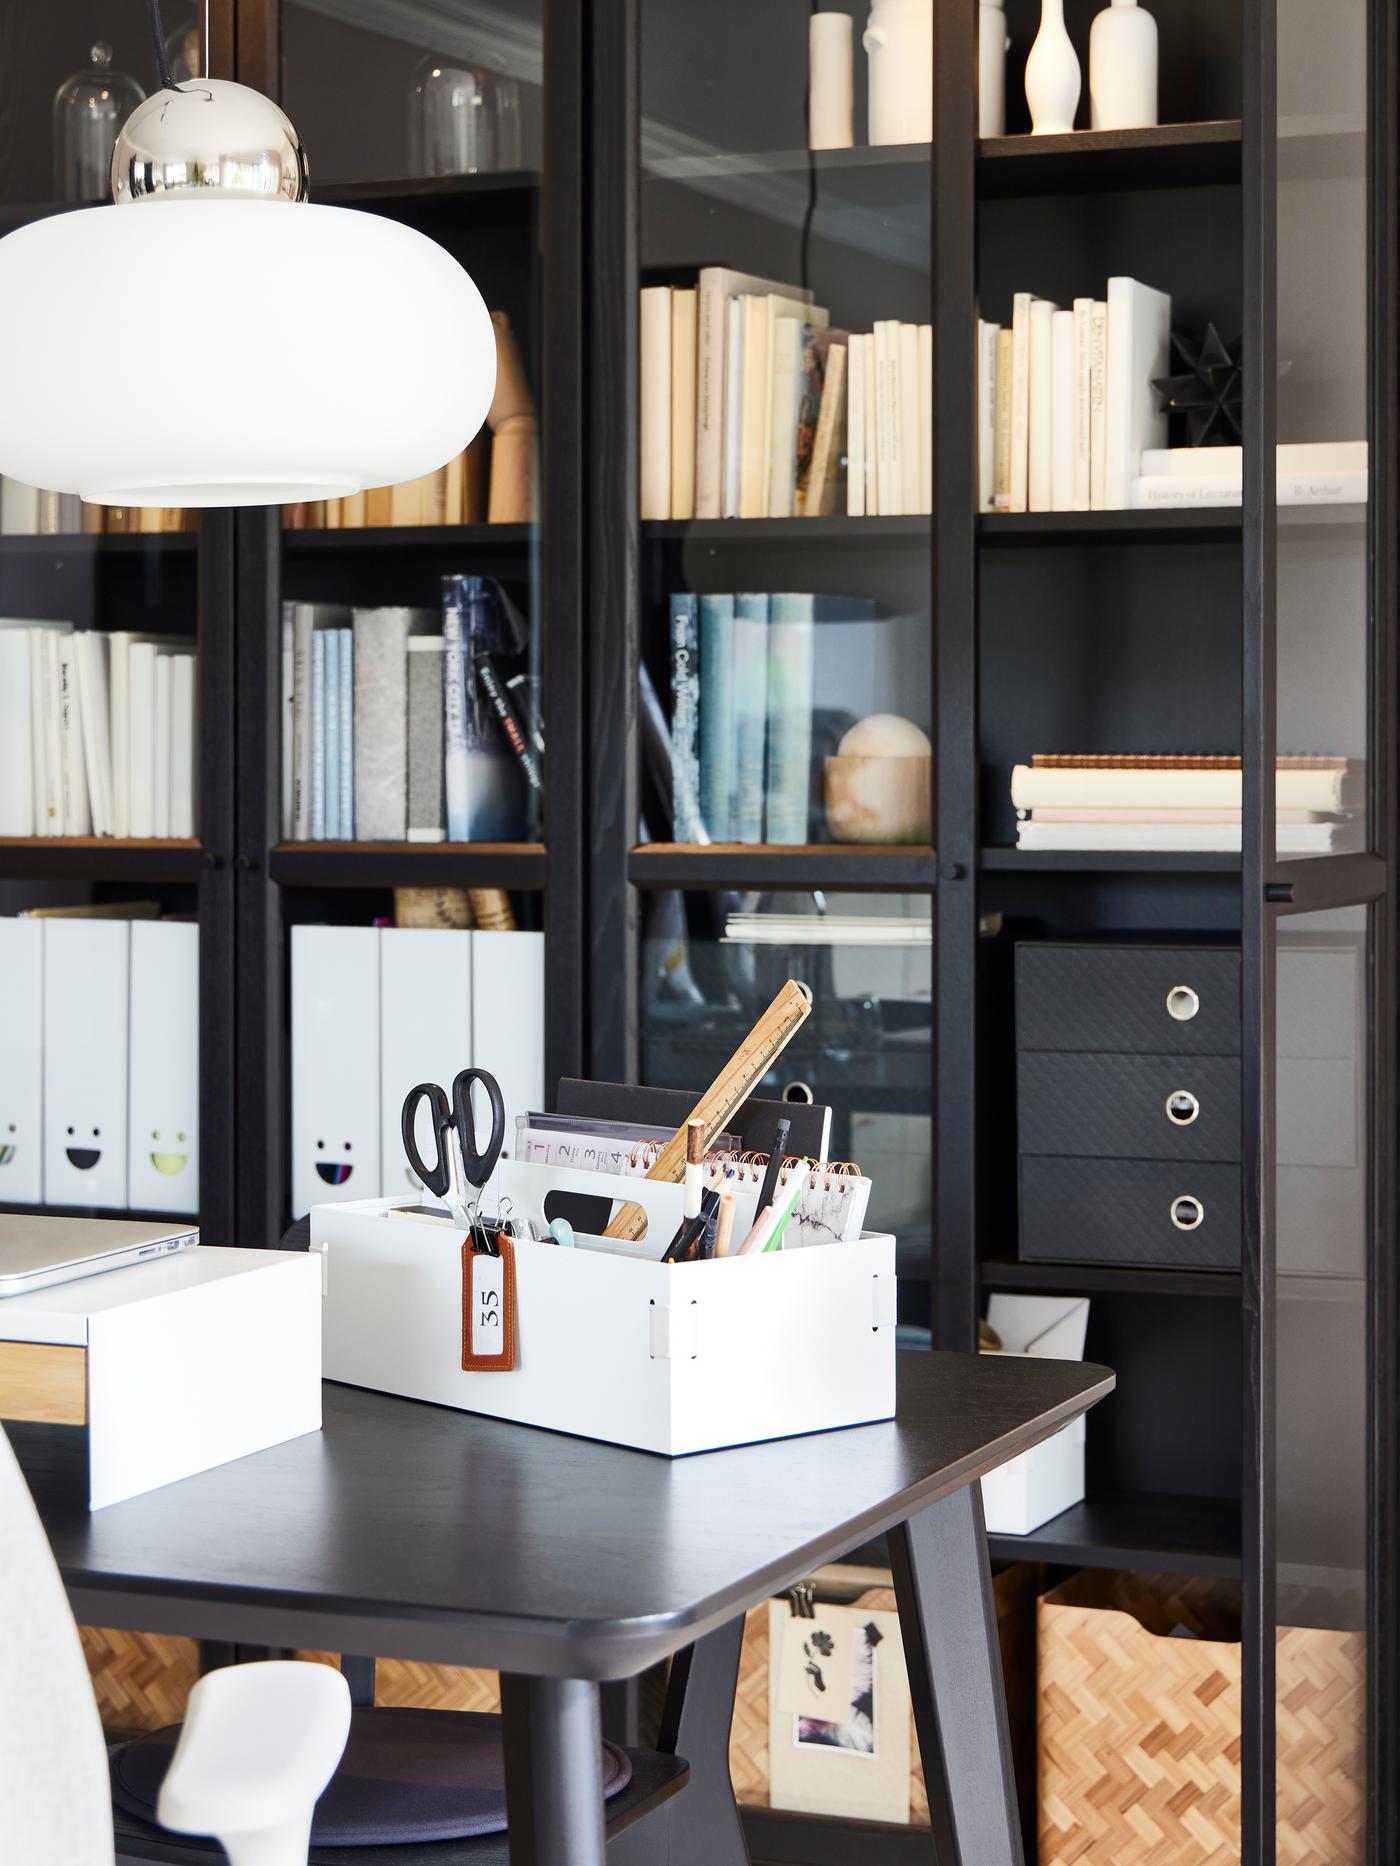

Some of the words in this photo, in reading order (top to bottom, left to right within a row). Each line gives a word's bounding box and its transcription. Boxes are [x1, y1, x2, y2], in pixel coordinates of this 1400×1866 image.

[675, 648, 690, 681] Cold
[559, 1145, 571, 1156] 2
[585, 1149, 596, 1160] 3
[611, 1152, 622, 1164] 4
[481, 1290, 499, 1327] 35
